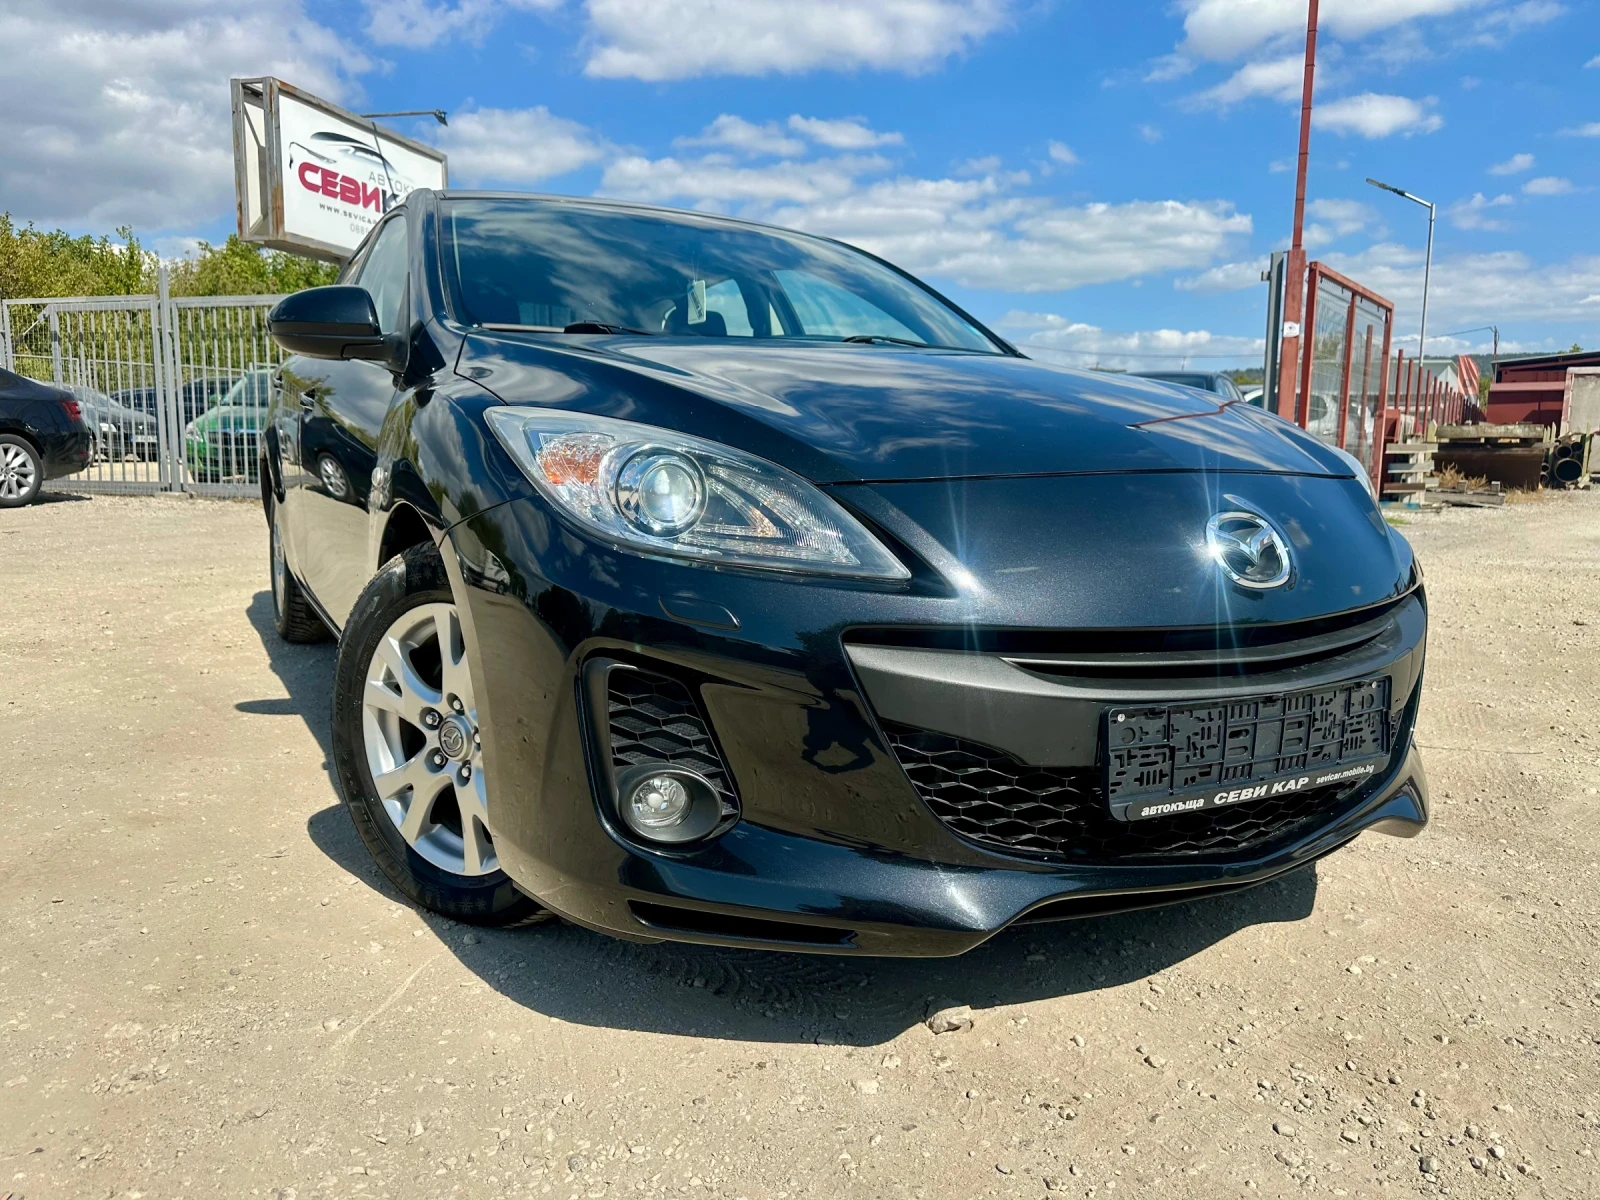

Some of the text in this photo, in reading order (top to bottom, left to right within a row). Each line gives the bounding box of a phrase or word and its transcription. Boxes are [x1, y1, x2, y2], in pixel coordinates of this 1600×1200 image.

[1141, 764, 1375, 816] автокъща СЕВИ КАР sevicar.mobile.bg
[348, 794, 421, 898] MICHELIN
